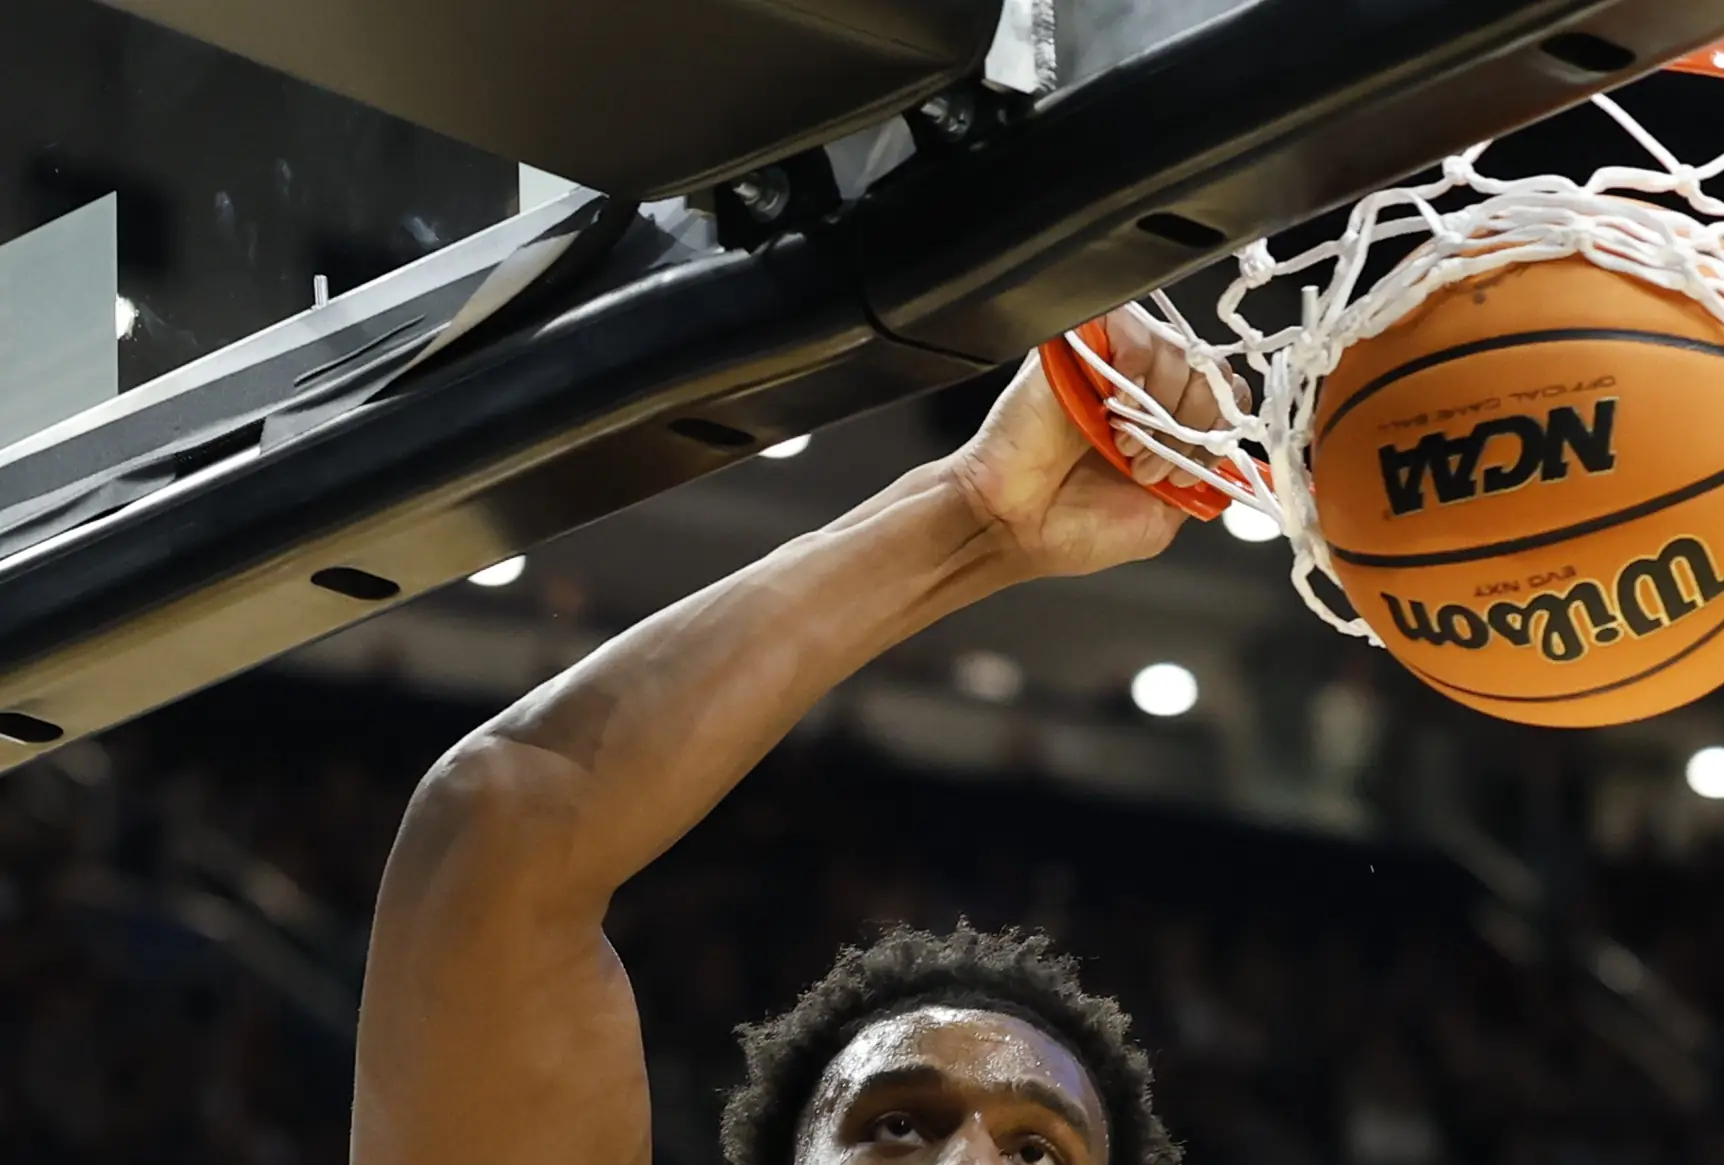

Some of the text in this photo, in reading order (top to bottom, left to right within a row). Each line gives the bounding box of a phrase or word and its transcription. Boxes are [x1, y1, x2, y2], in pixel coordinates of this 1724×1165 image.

[1507, 375, 1617, 403] OFFICIAL
[1377, 395, 1620, 518] NCAA
[1474, 564, 1577, 598] EVO NXT
